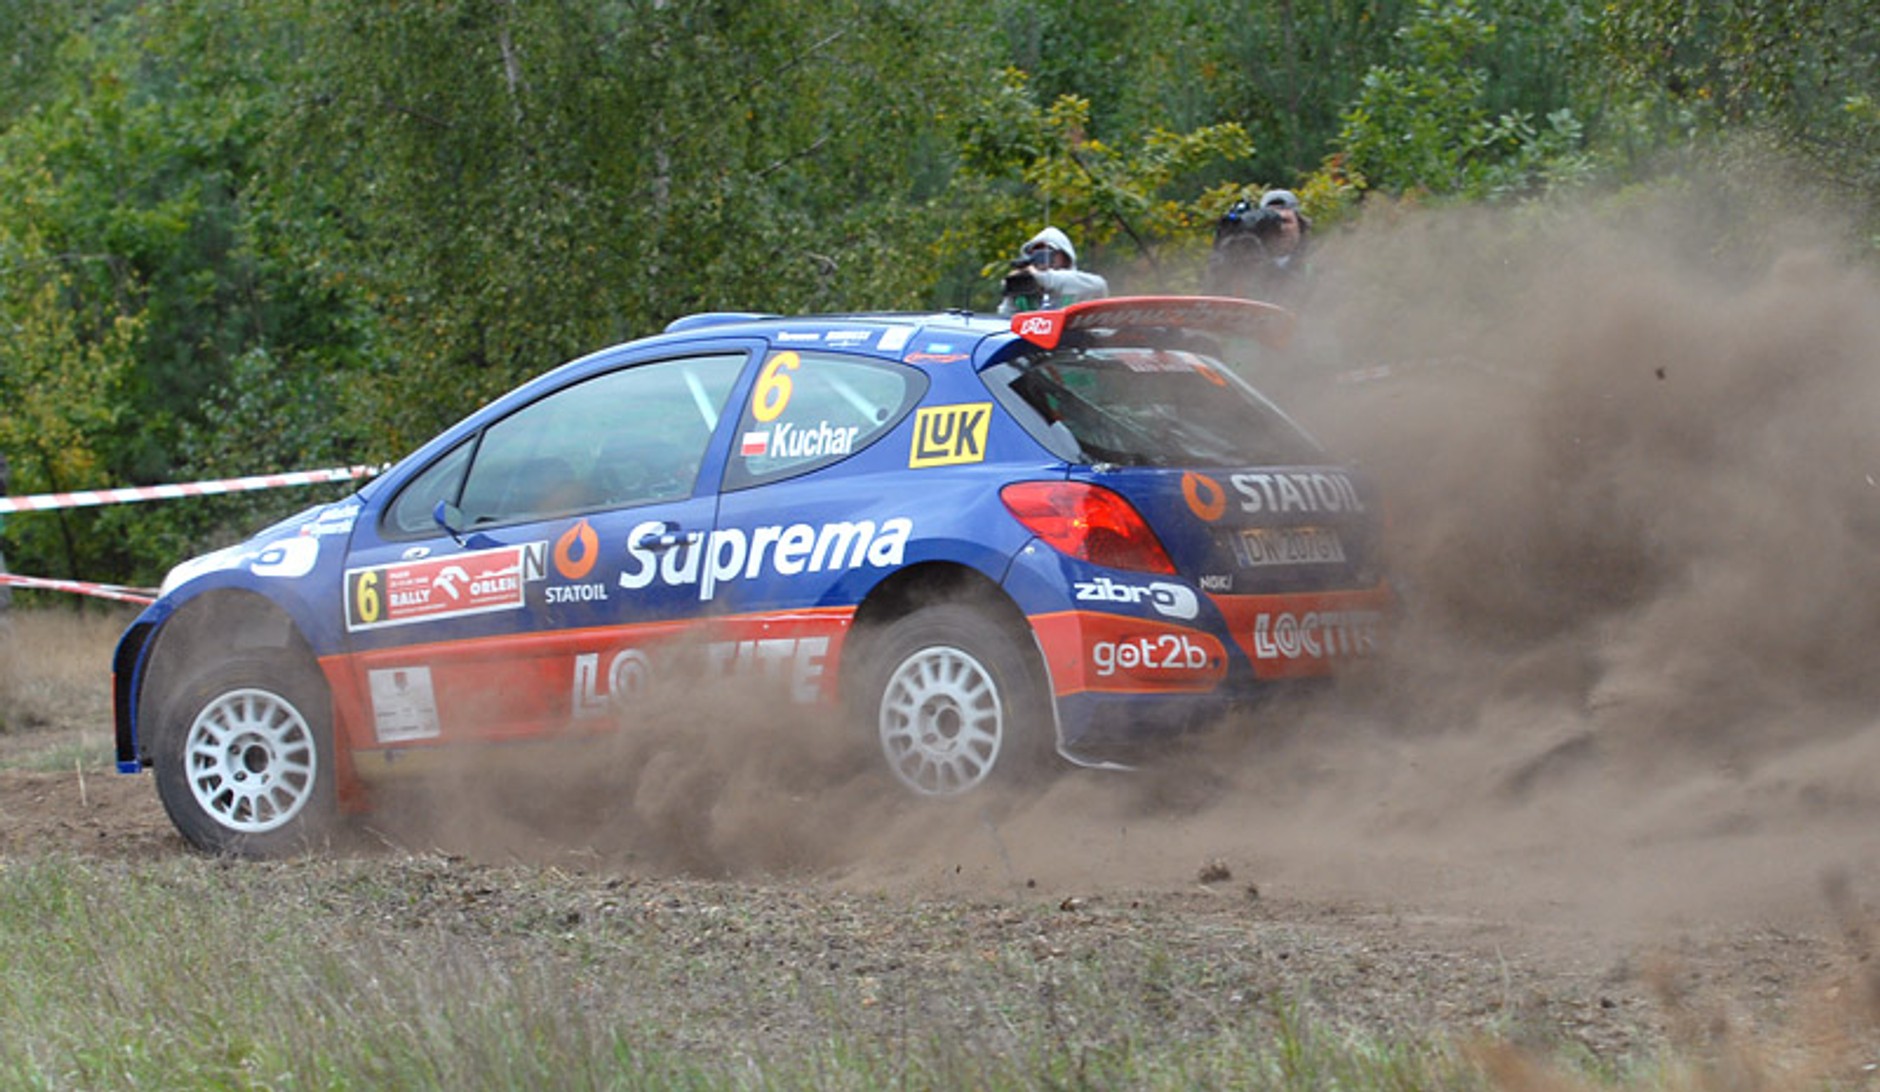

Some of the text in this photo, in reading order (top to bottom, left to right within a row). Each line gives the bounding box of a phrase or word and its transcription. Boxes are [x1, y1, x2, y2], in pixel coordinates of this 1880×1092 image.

[752, 351, 801, 422] 6
[770, 421, 859, 458] Kuchar
[1230, 473, 1366, 513] STATOIL
[524, 545, 545, 580] N
[619, 517, 913, 600] Suprema
[357, 571, 380, 623] 6
[390, 589, 430, 607] RALLY
[469, 578, 517, 596] ORLEN
[545, 584, 608, 604] STATOIL
[1093, 635, 1207, 676] got2b
[573, 636, 829, 720] LOTITE
